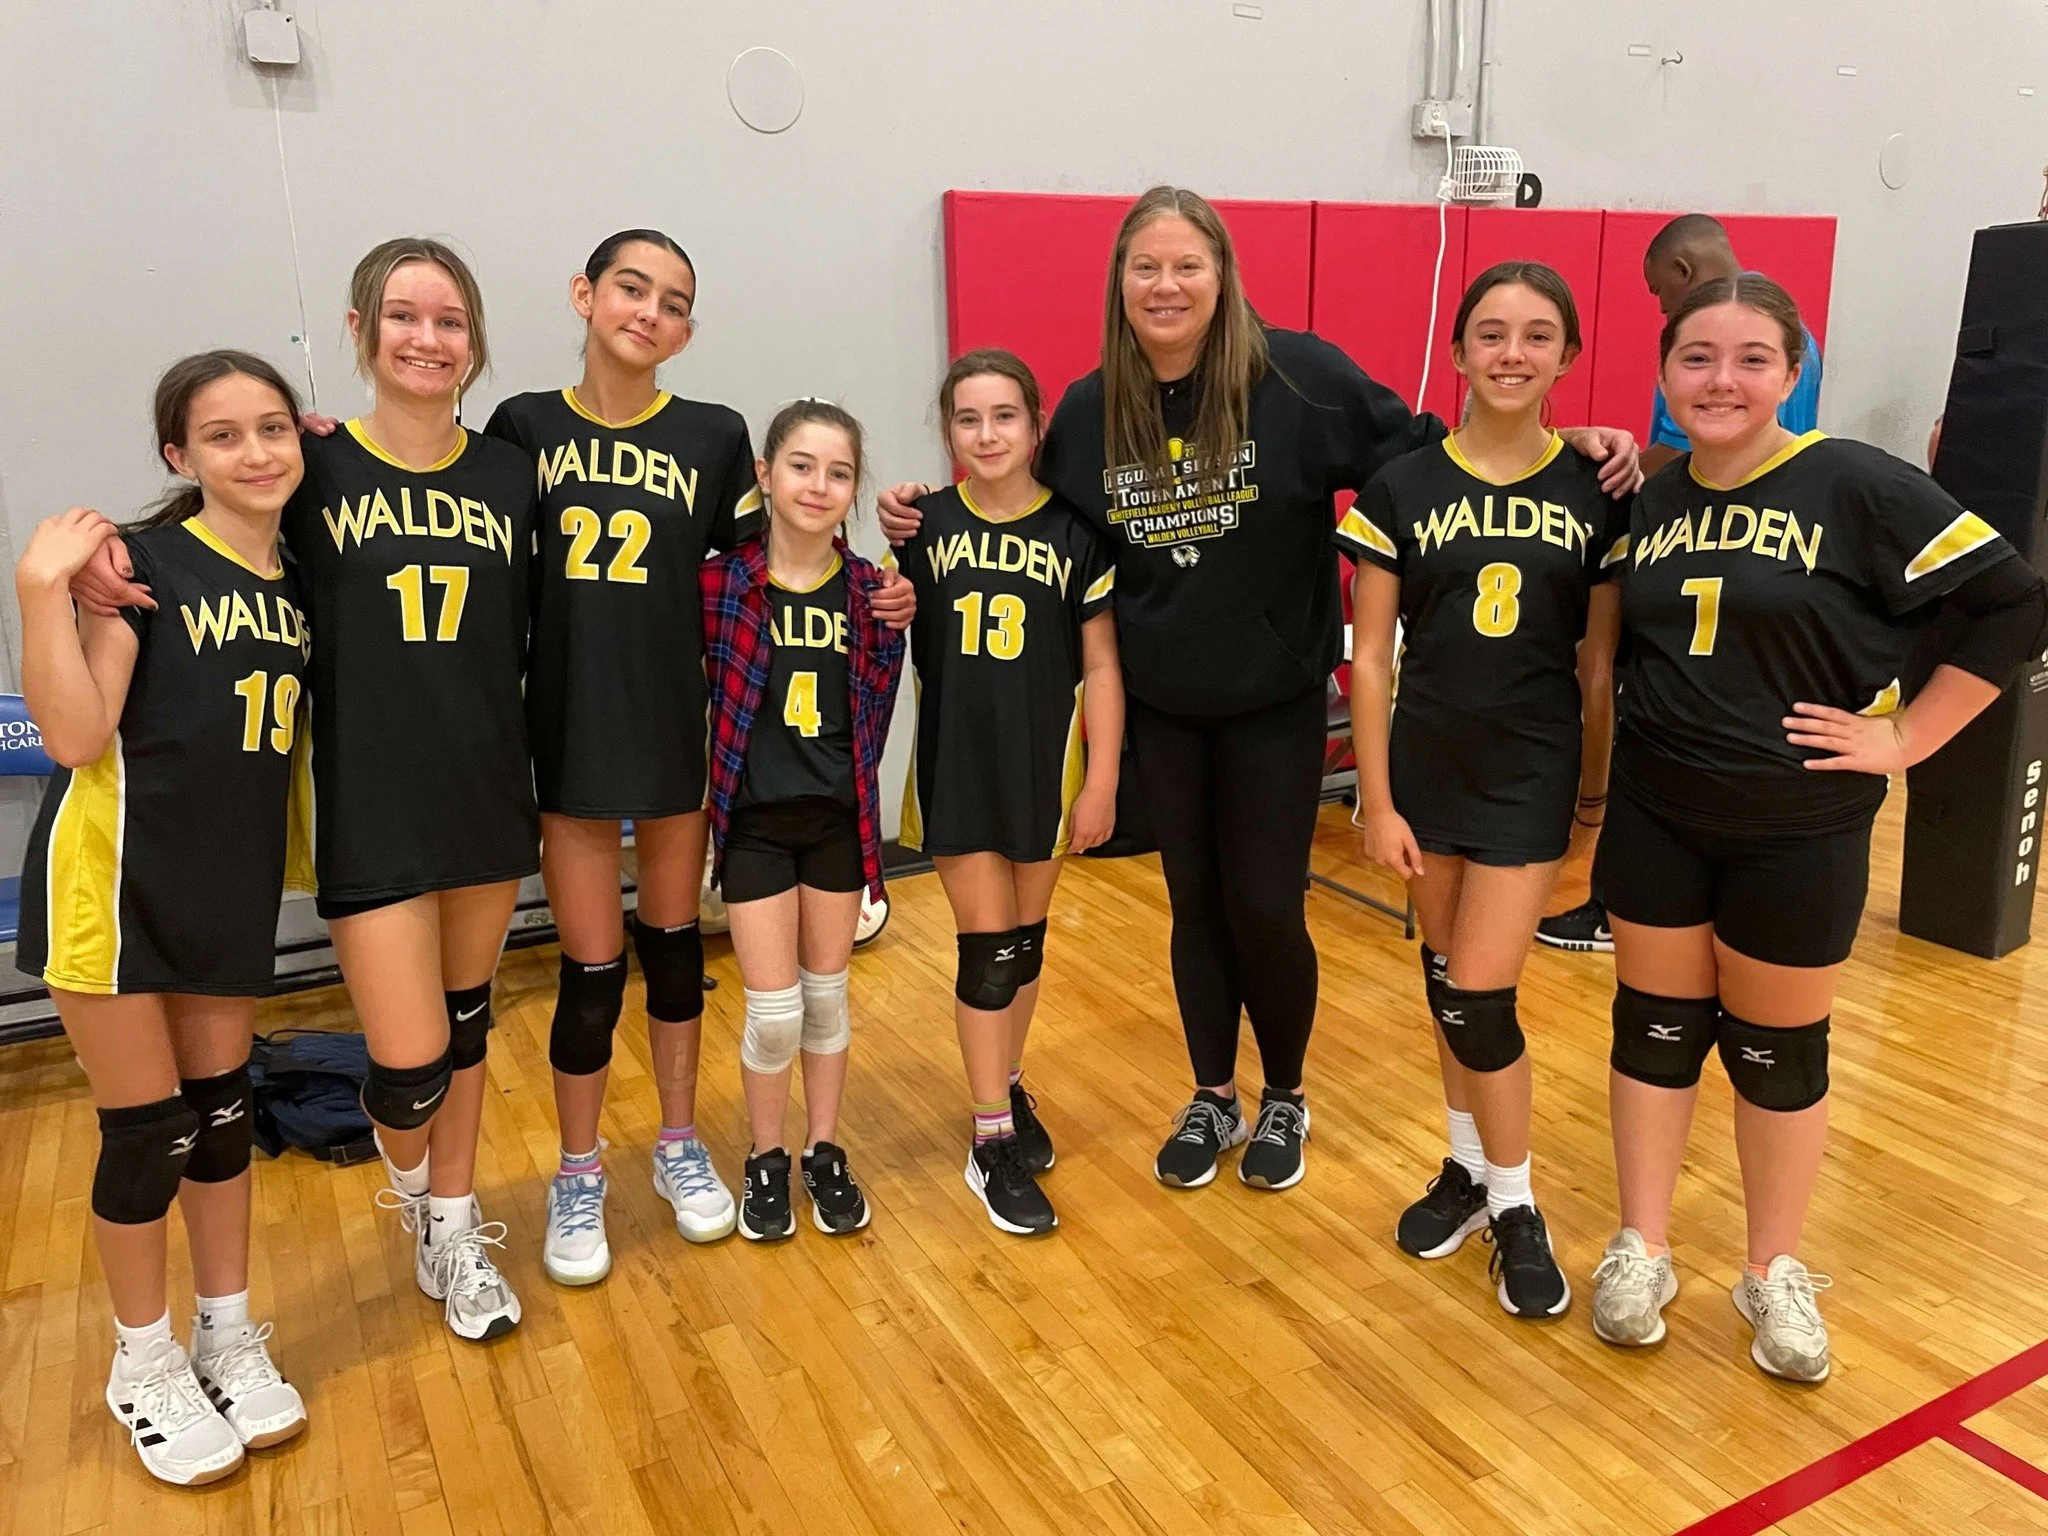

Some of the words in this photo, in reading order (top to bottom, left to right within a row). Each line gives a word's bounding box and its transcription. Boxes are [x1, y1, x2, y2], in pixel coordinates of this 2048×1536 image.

[321, 487, 512, 566] WALDEN
[1130, 504, 1235, 539] CHAMPIONS
[1227, 489, 1255, 502] LEAGUE
[1413, 495, 1594, 566] WALDEN
[560, 506, 651, 584] 22
[926, 530, 1073, 601] WALDEN
[1147, 531, 1176, 543] WALDEN
[1177, 523, 1219, 540] VOLLEYBALL
[1634, 504, 1824, 576] WALDEN
[180, 590, 312, 667] WALDE
[386, 564, 469, 641] 17
[953, 591, 1026, 660] 13
[1473, 562, 1522, 637] 8
[1681, 577, 1723, 656] 1
[234, 670, 300, 755] 19
[783, 671, 822, 737] 4
